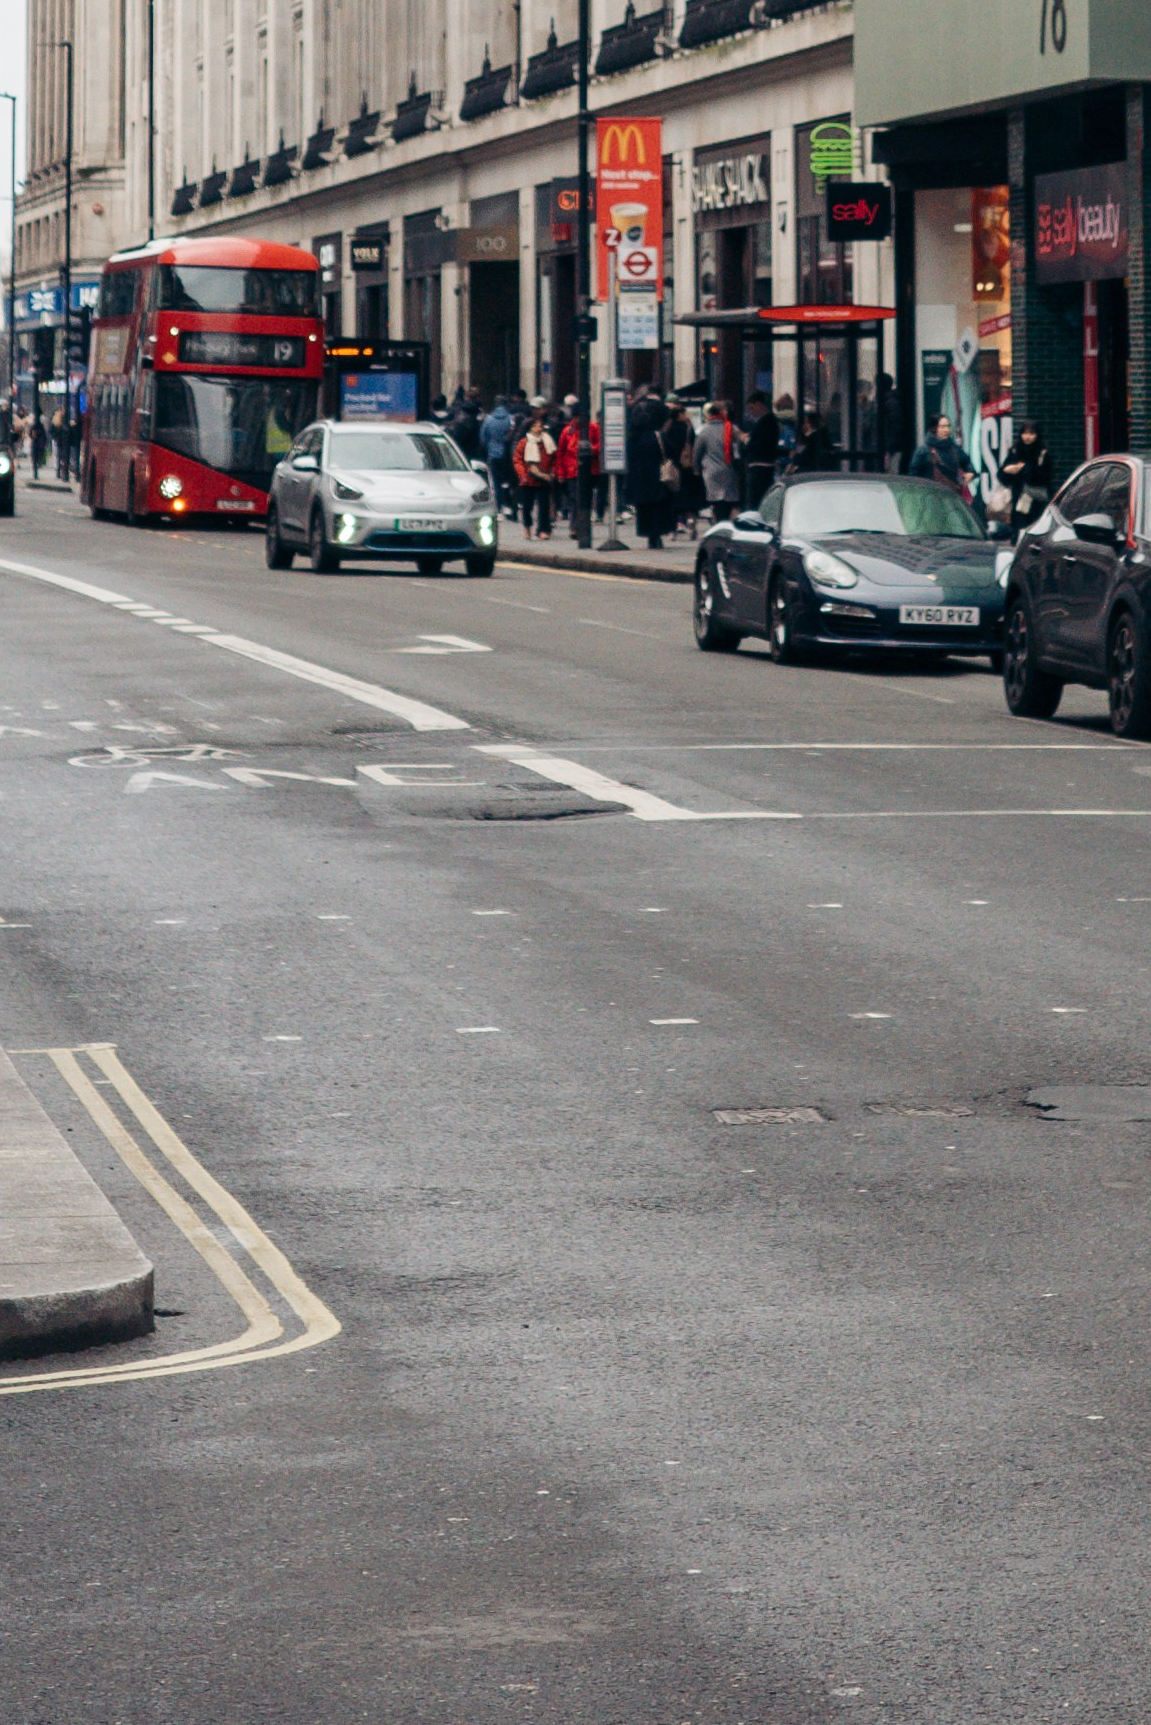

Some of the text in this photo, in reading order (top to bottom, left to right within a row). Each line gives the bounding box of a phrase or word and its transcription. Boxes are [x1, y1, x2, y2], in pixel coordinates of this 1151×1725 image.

[832, 199, 880, 225] sally
[274, 341, 293, 361] 19
[905, 608, 943, 622] KY60
